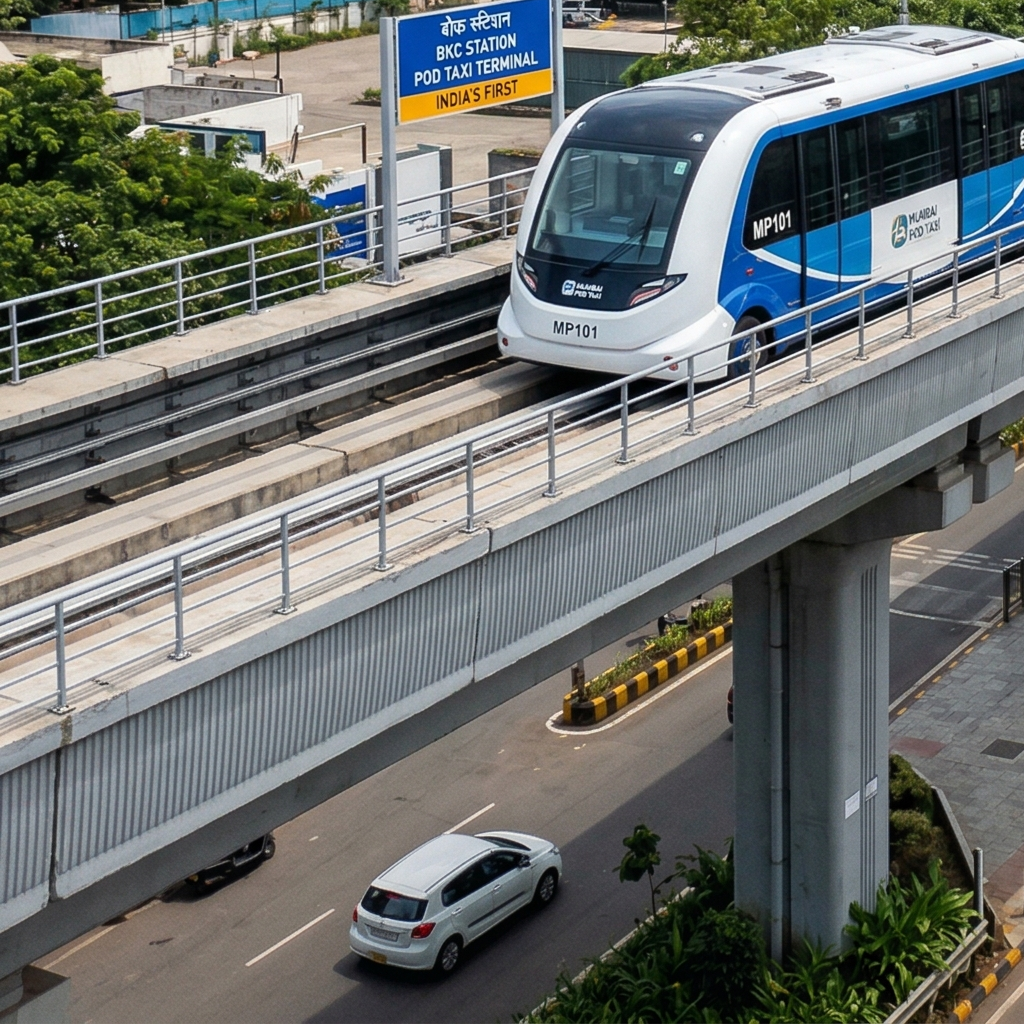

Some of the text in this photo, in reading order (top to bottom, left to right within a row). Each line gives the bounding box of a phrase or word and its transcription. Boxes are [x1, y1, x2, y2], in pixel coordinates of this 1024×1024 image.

[436, 33, 517, 62] BKC STATION
[414, 51, 539, 87] POD TAXI TERMINAL
[436, 79, 518, 110] INDIA'S FIRST
[753, 210, 792, 240] MP101
[553, 320, 597, 339] MP101
